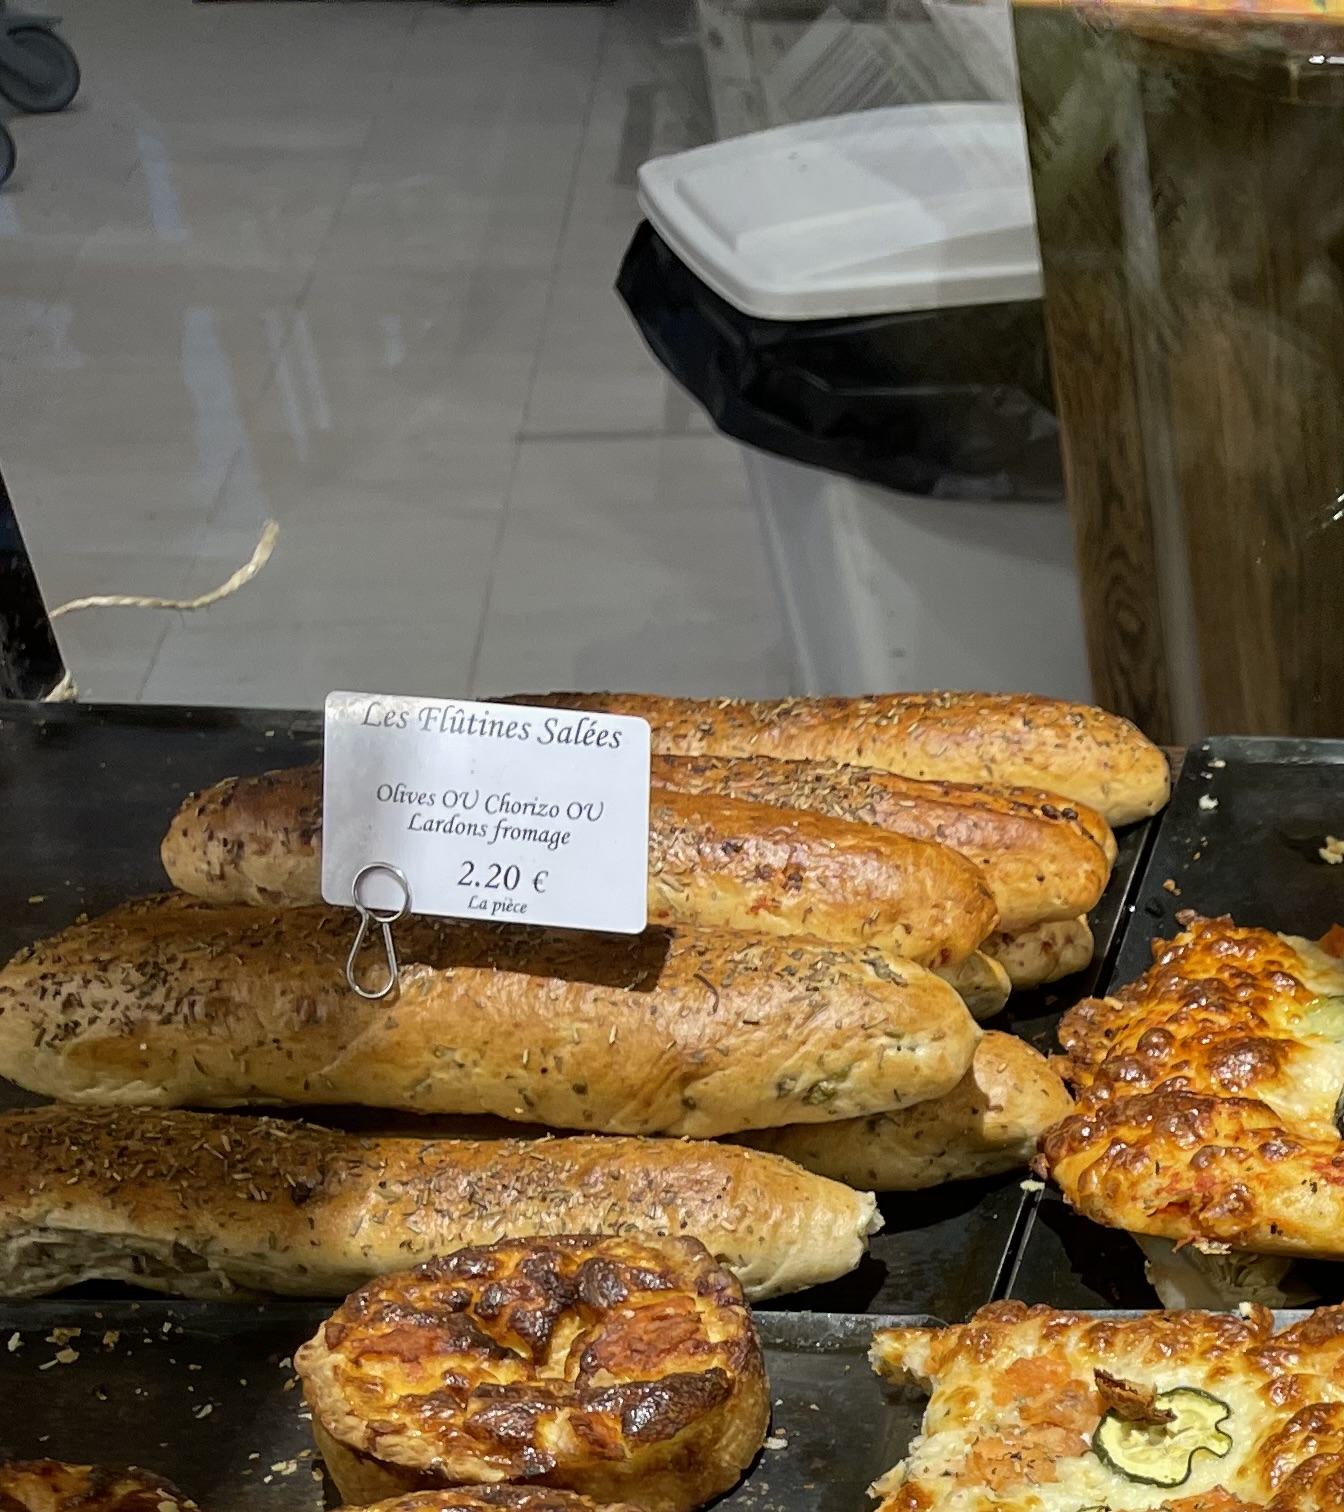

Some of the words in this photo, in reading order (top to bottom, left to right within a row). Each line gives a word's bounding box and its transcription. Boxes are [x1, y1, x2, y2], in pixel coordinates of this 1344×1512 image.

[361, 701, 408, 729] Les
[418, 704, 532, 741] Flûtines
[536, 717, 623, 749] Salées
[376, 783, 436, 807] Olives
[442, 790, 480, 810] OU
[484, 793, 560, 818] Chorizo
[566, 801, 605, 822] OU
[407, 813, 487, 838] Lardons
[487, 818, 571, 850] fromage
[456, 860, 521, 891] 2.20
[533, 870, 549, 893] €
[468, 895, 489, 910] La
[490, 899, 528, 916] pièce
